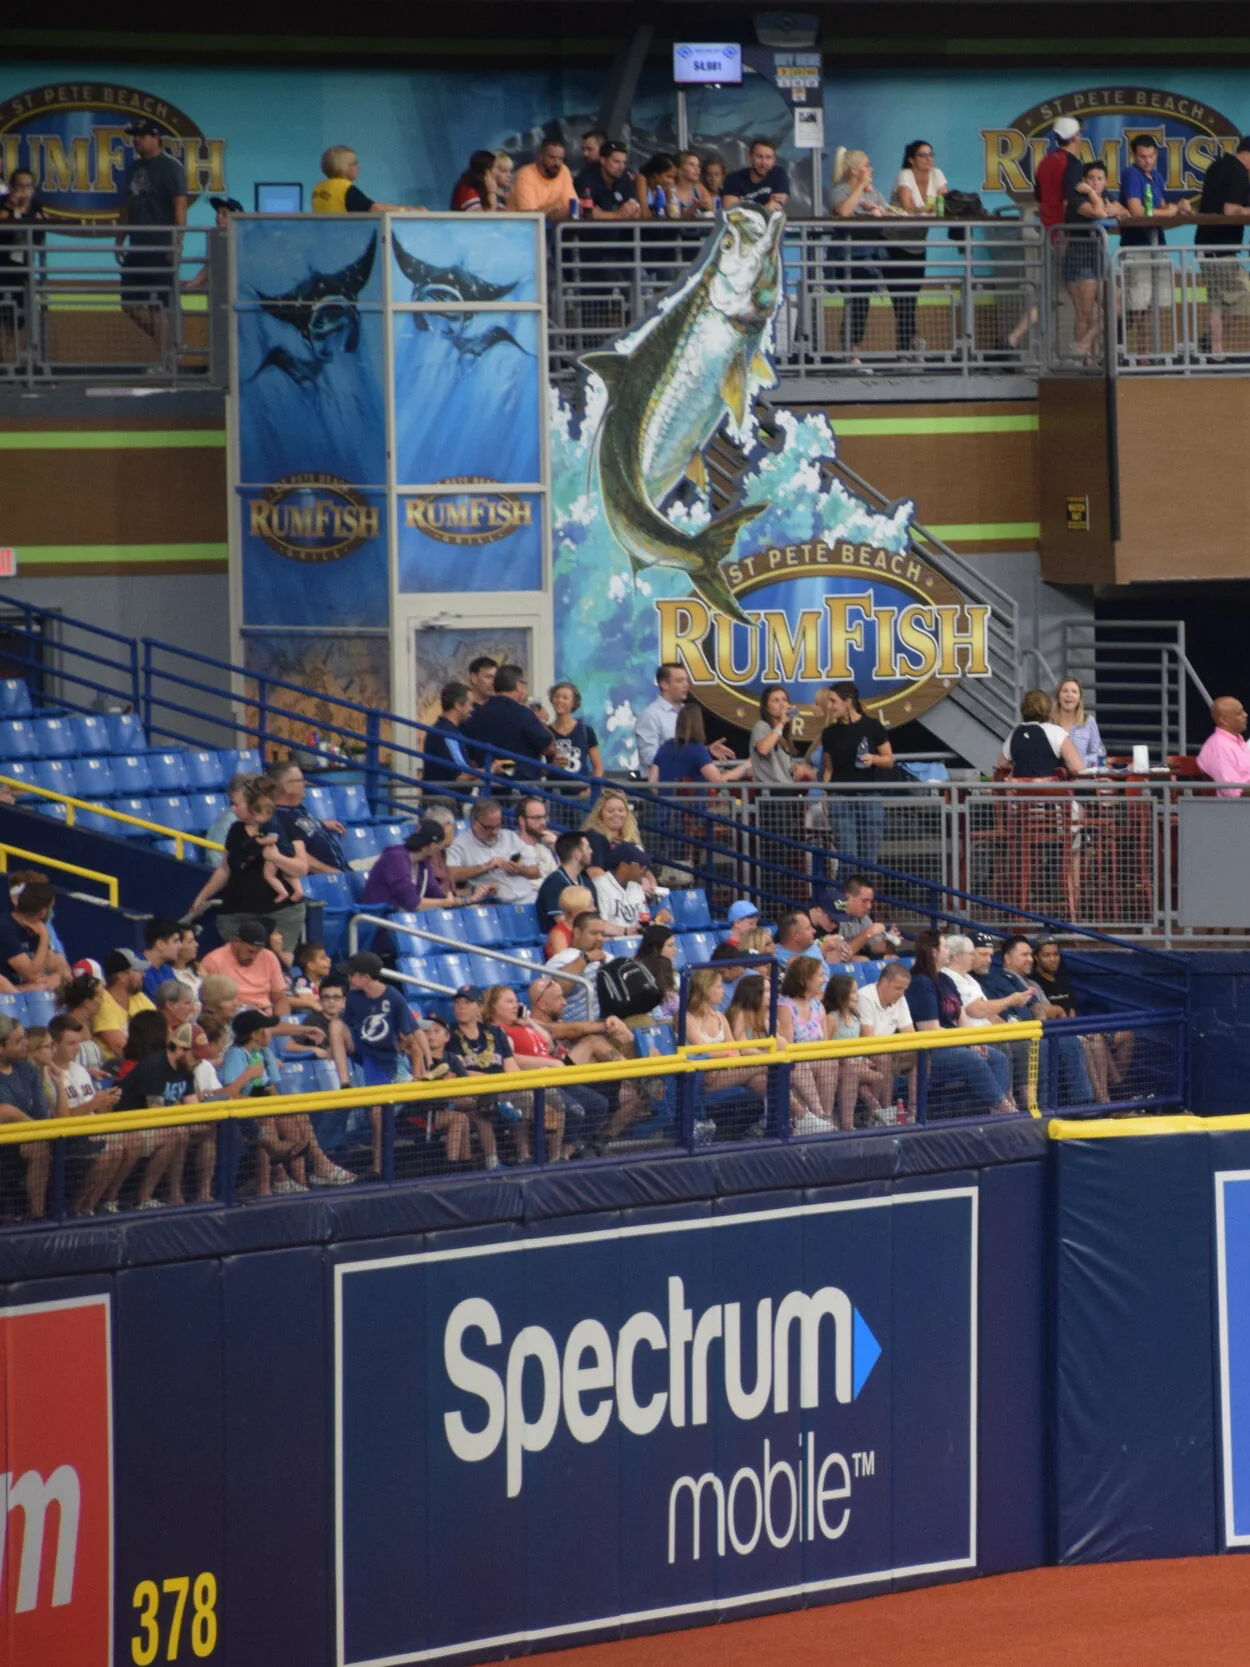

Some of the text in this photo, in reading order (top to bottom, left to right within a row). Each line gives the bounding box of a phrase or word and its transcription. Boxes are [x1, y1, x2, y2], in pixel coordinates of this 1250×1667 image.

[12, 86, 168, 119] ST PETE BEACH
[1040, 90, 1204, 120] ST PETE BEACH
[0, 125, 226, 194] UMFH
[248, 499, 380, 538] RUMFISH
[404, 497, 532, 527] RUMFISH
[729, 543, 922, 584] ST PETE BEACH
[655, 589, 992, 685] RUMFISH
[444, 1276, 852, 1498] Spectrum
[131, 1571, 217, 1666] 378
